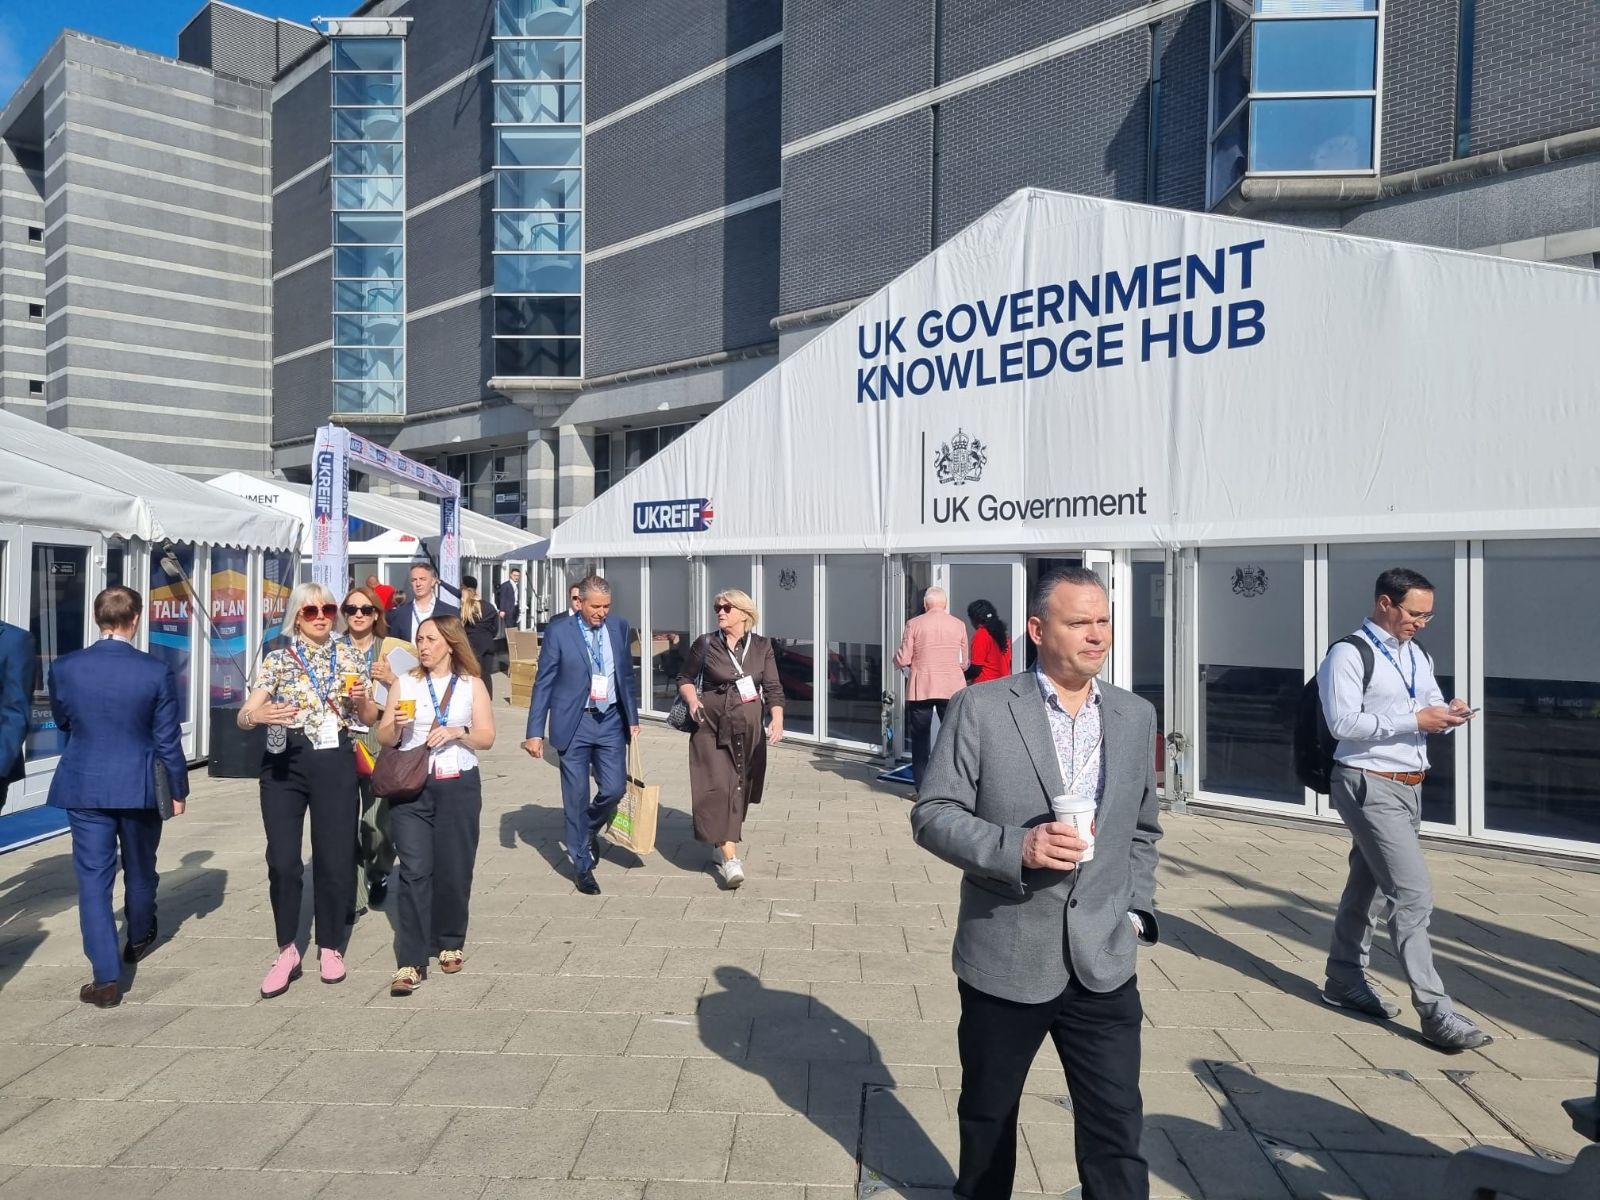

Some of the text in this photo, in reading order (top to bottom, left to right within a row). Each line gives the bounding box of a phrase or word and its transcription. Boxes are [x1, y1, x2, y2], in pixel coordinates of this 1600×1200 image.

[858, 239, 1265, 359] UK GOVERNMENT
[856, 299, 1266, 403] KNOWLEDGE HUB
[933, 487, 1147, 524] UK Government
[153, 600, 188, 618] TALK
[212, 600, 245, 617] PLAN
[263, 597, 286, 613] BUIL
